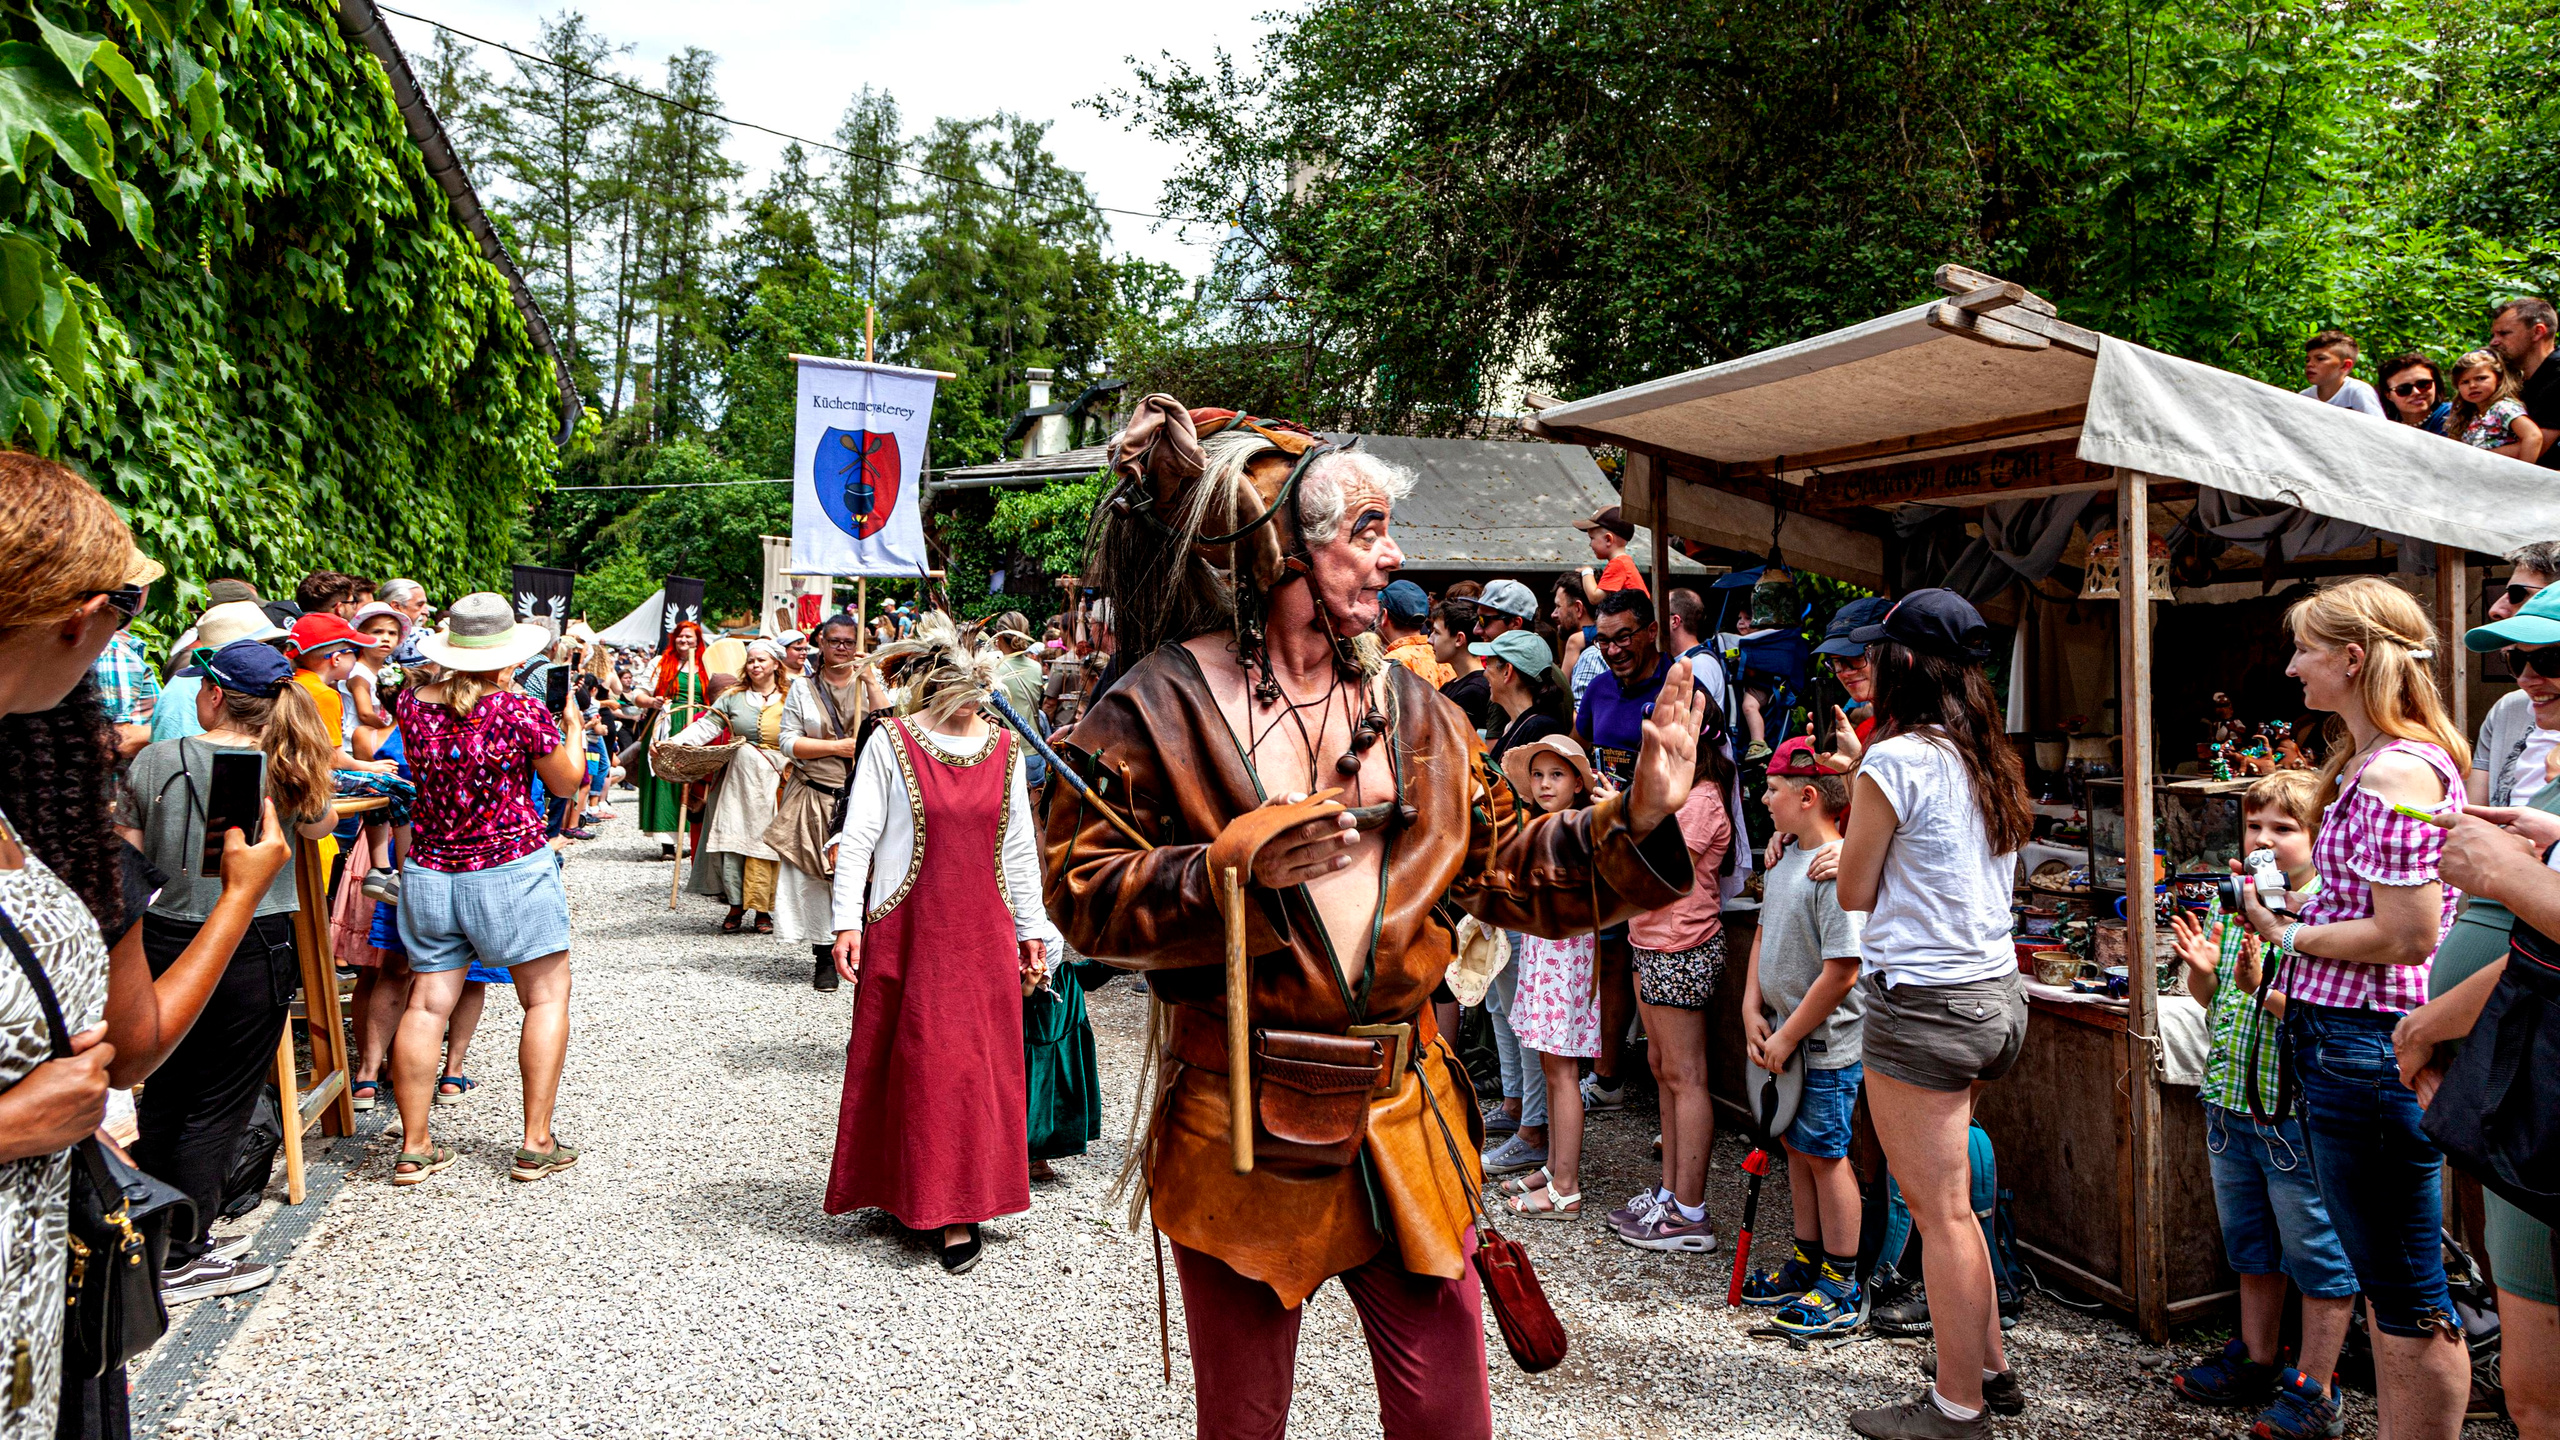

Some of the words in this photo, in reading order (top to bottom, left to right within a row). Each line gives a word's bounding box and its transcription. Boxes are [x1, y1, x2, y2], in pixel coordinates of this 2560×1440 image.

[813, 395, 915, 421] Küchenmeysterey
[1944, 461, 1981, 489] aus
[1990, 447, 2039, 488] Ton
[1902, 1321, 1933, 1331] MERR
